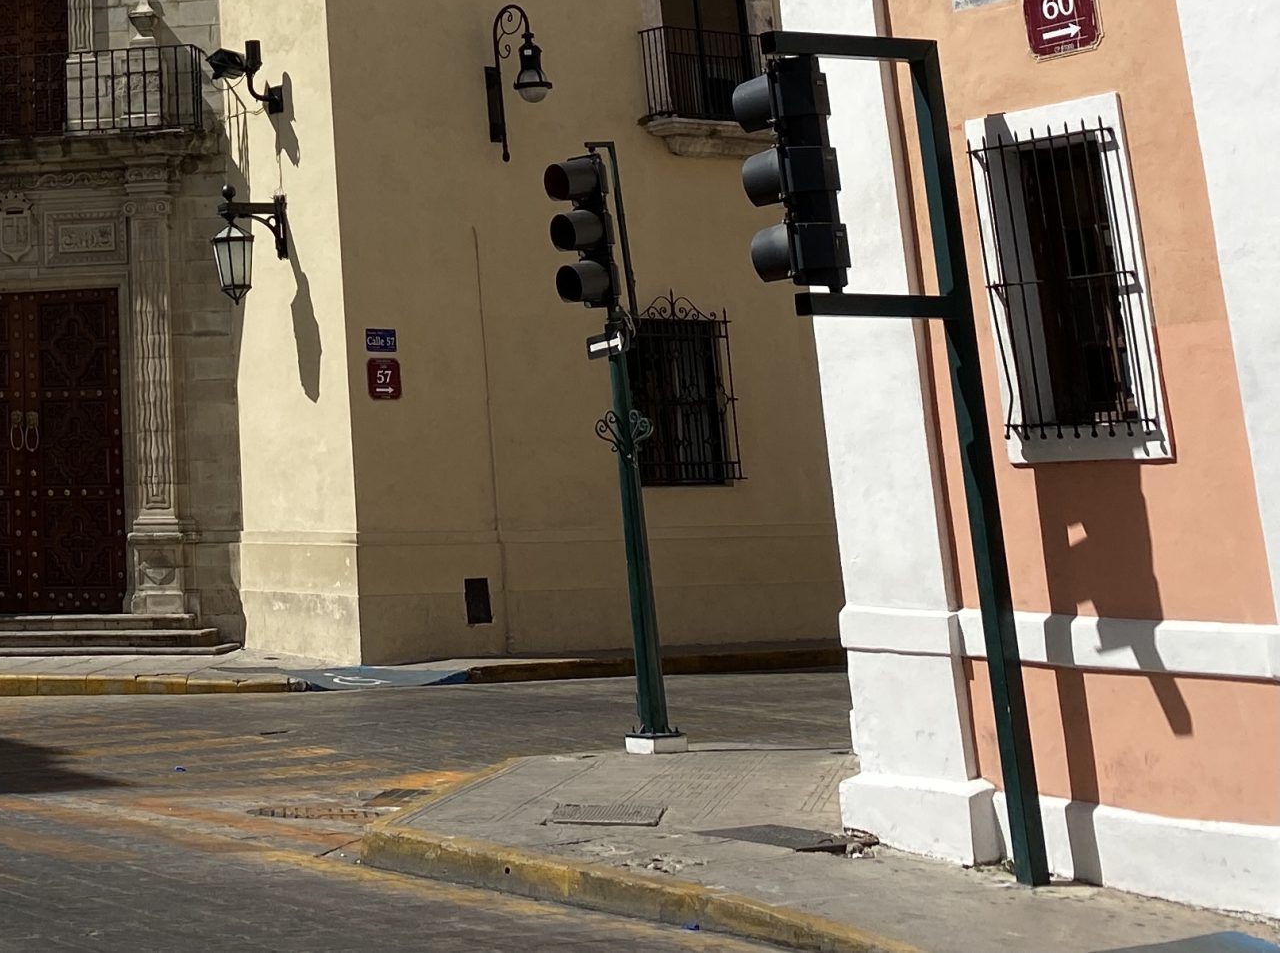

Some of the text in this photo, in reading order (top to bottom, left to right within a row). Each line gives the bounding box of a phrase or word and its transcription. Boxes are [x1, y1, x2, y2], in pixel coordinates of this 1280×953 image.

[367, 336, 395, 346] Calle 57
[376, 370, 392, 384] 57
